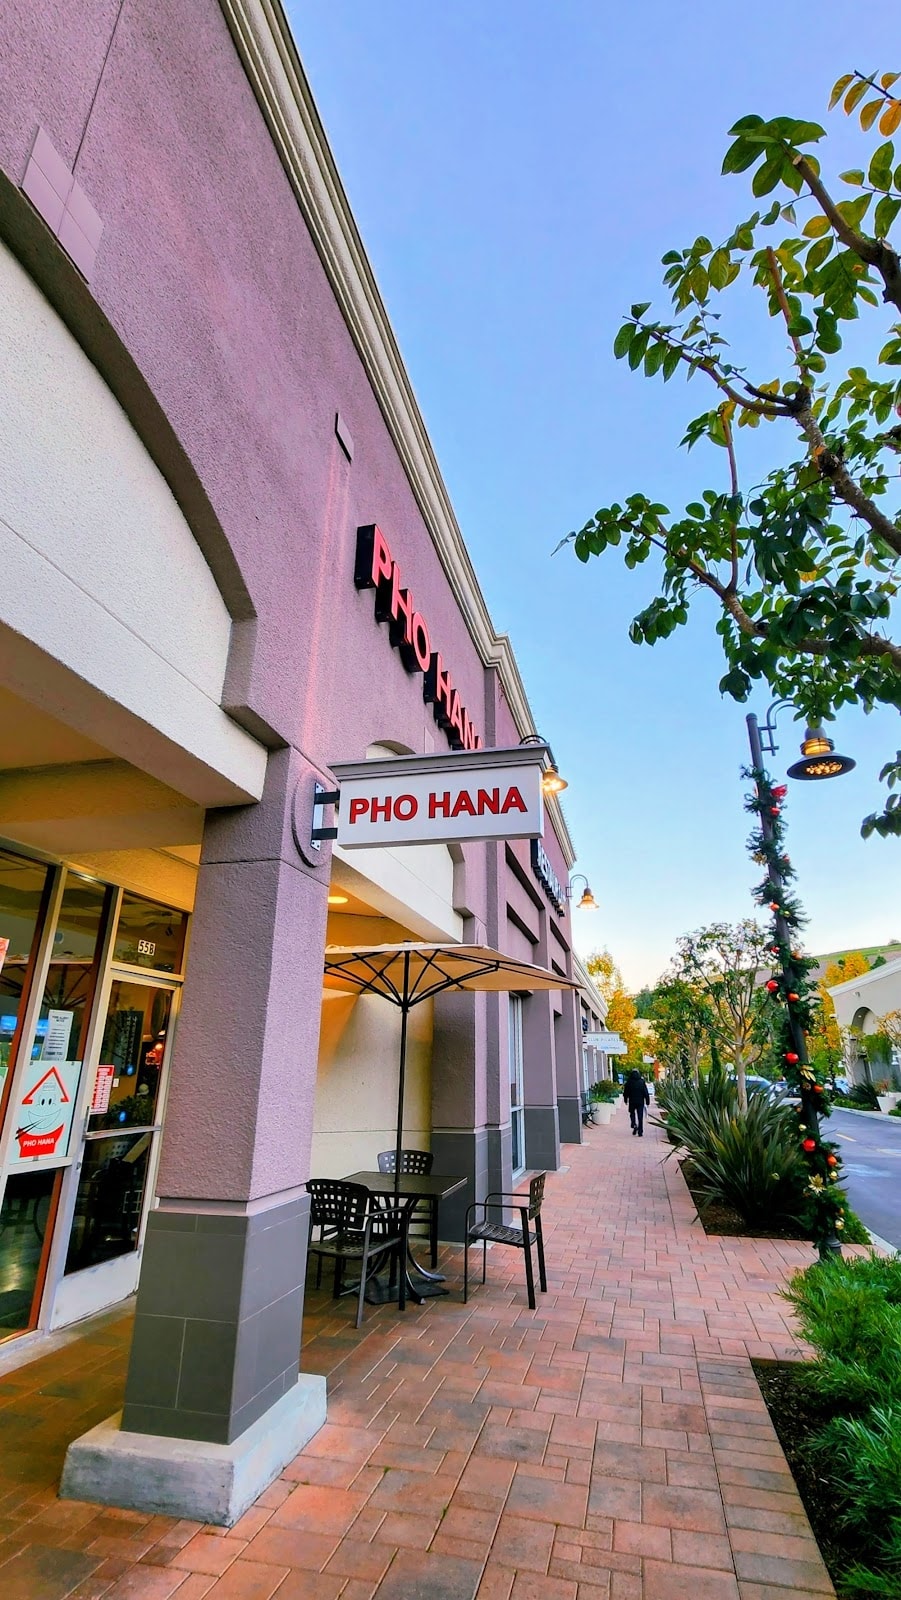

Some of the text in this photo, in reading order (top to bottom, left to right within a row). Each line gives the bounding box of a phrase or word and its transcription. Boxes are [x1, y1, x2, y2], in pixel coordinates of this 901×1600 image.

[370, 524, 431, 673] PHO
[349, 786, 528, 824] PHO HANA
[139, 941, 154, 955] 55B
[23, 1137, 55, 1147] PHO HANA
